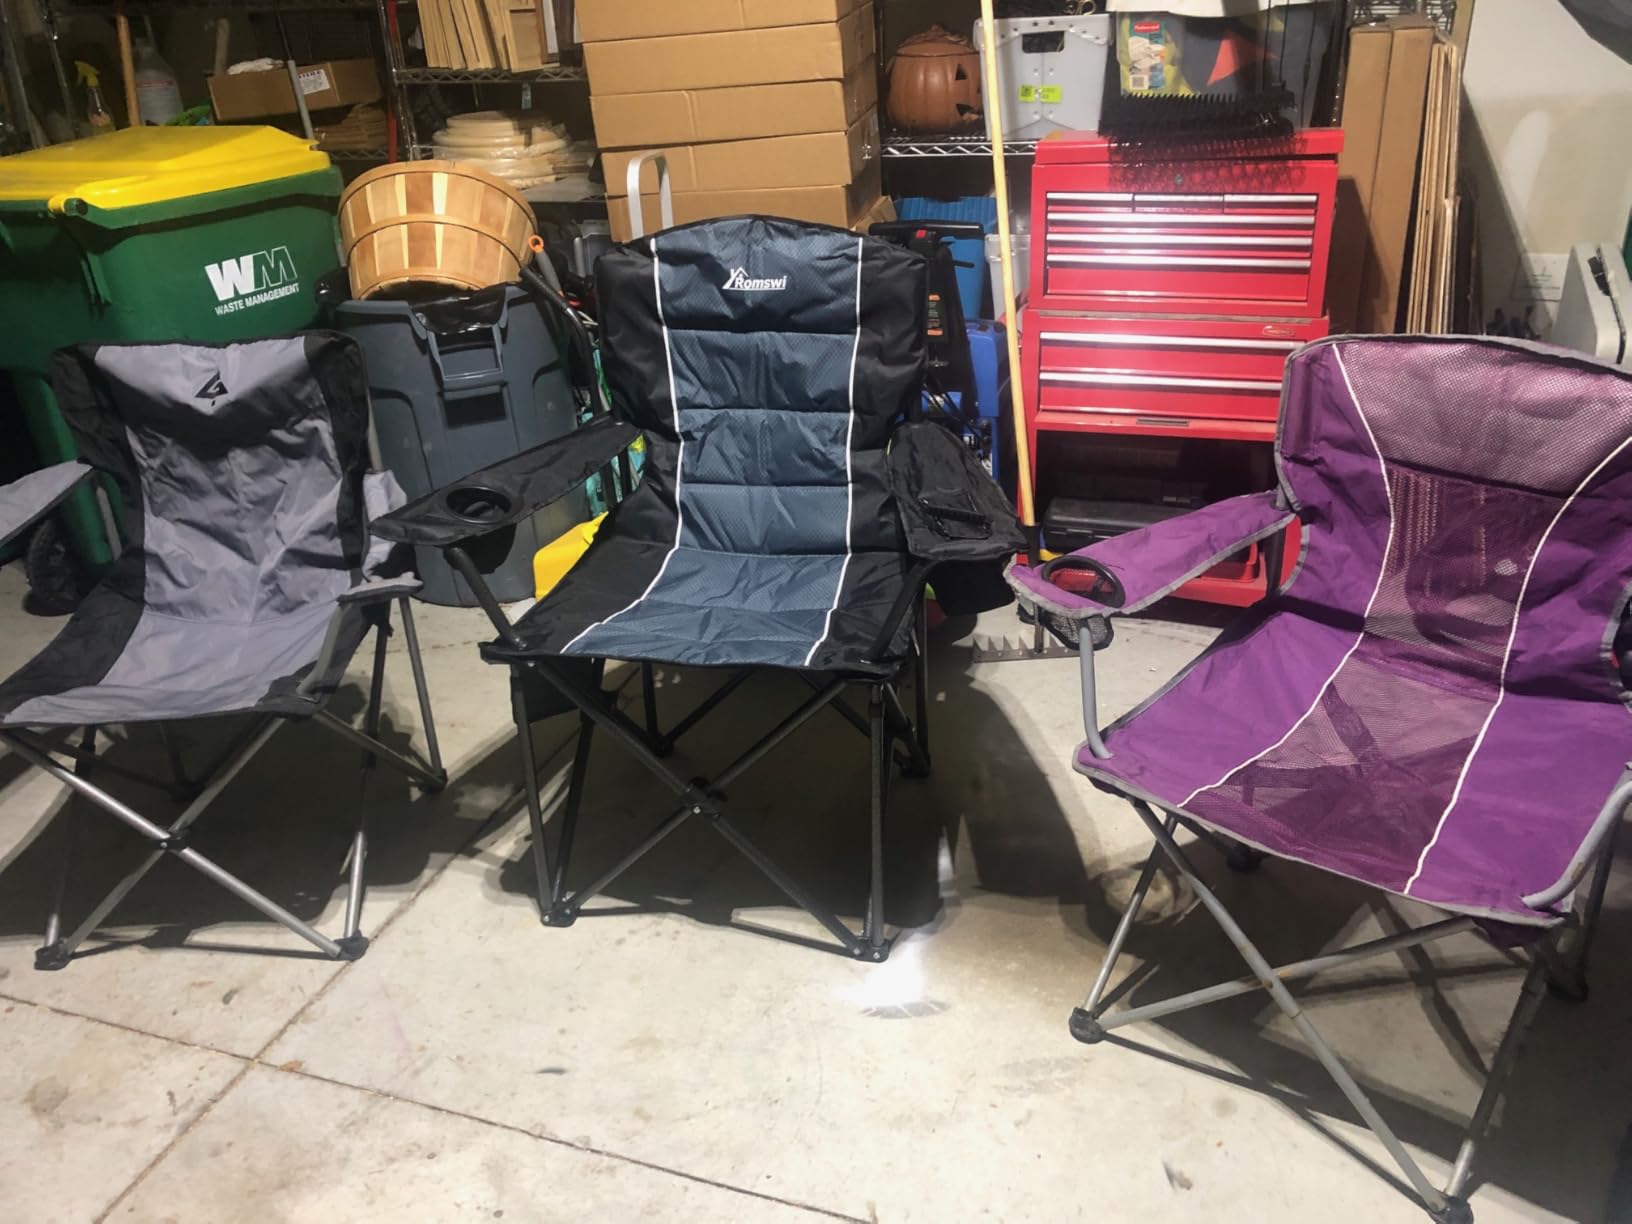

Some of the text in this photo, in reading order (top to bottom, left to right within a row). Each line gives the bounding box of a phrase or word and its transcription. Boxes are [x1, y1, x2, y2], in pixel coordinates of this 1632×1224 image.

[204, 246, 298, 302] WM
[733, 274, 788, 290] Romswi
[214, 282, 300, 316] WASTE MANAGEMENT
